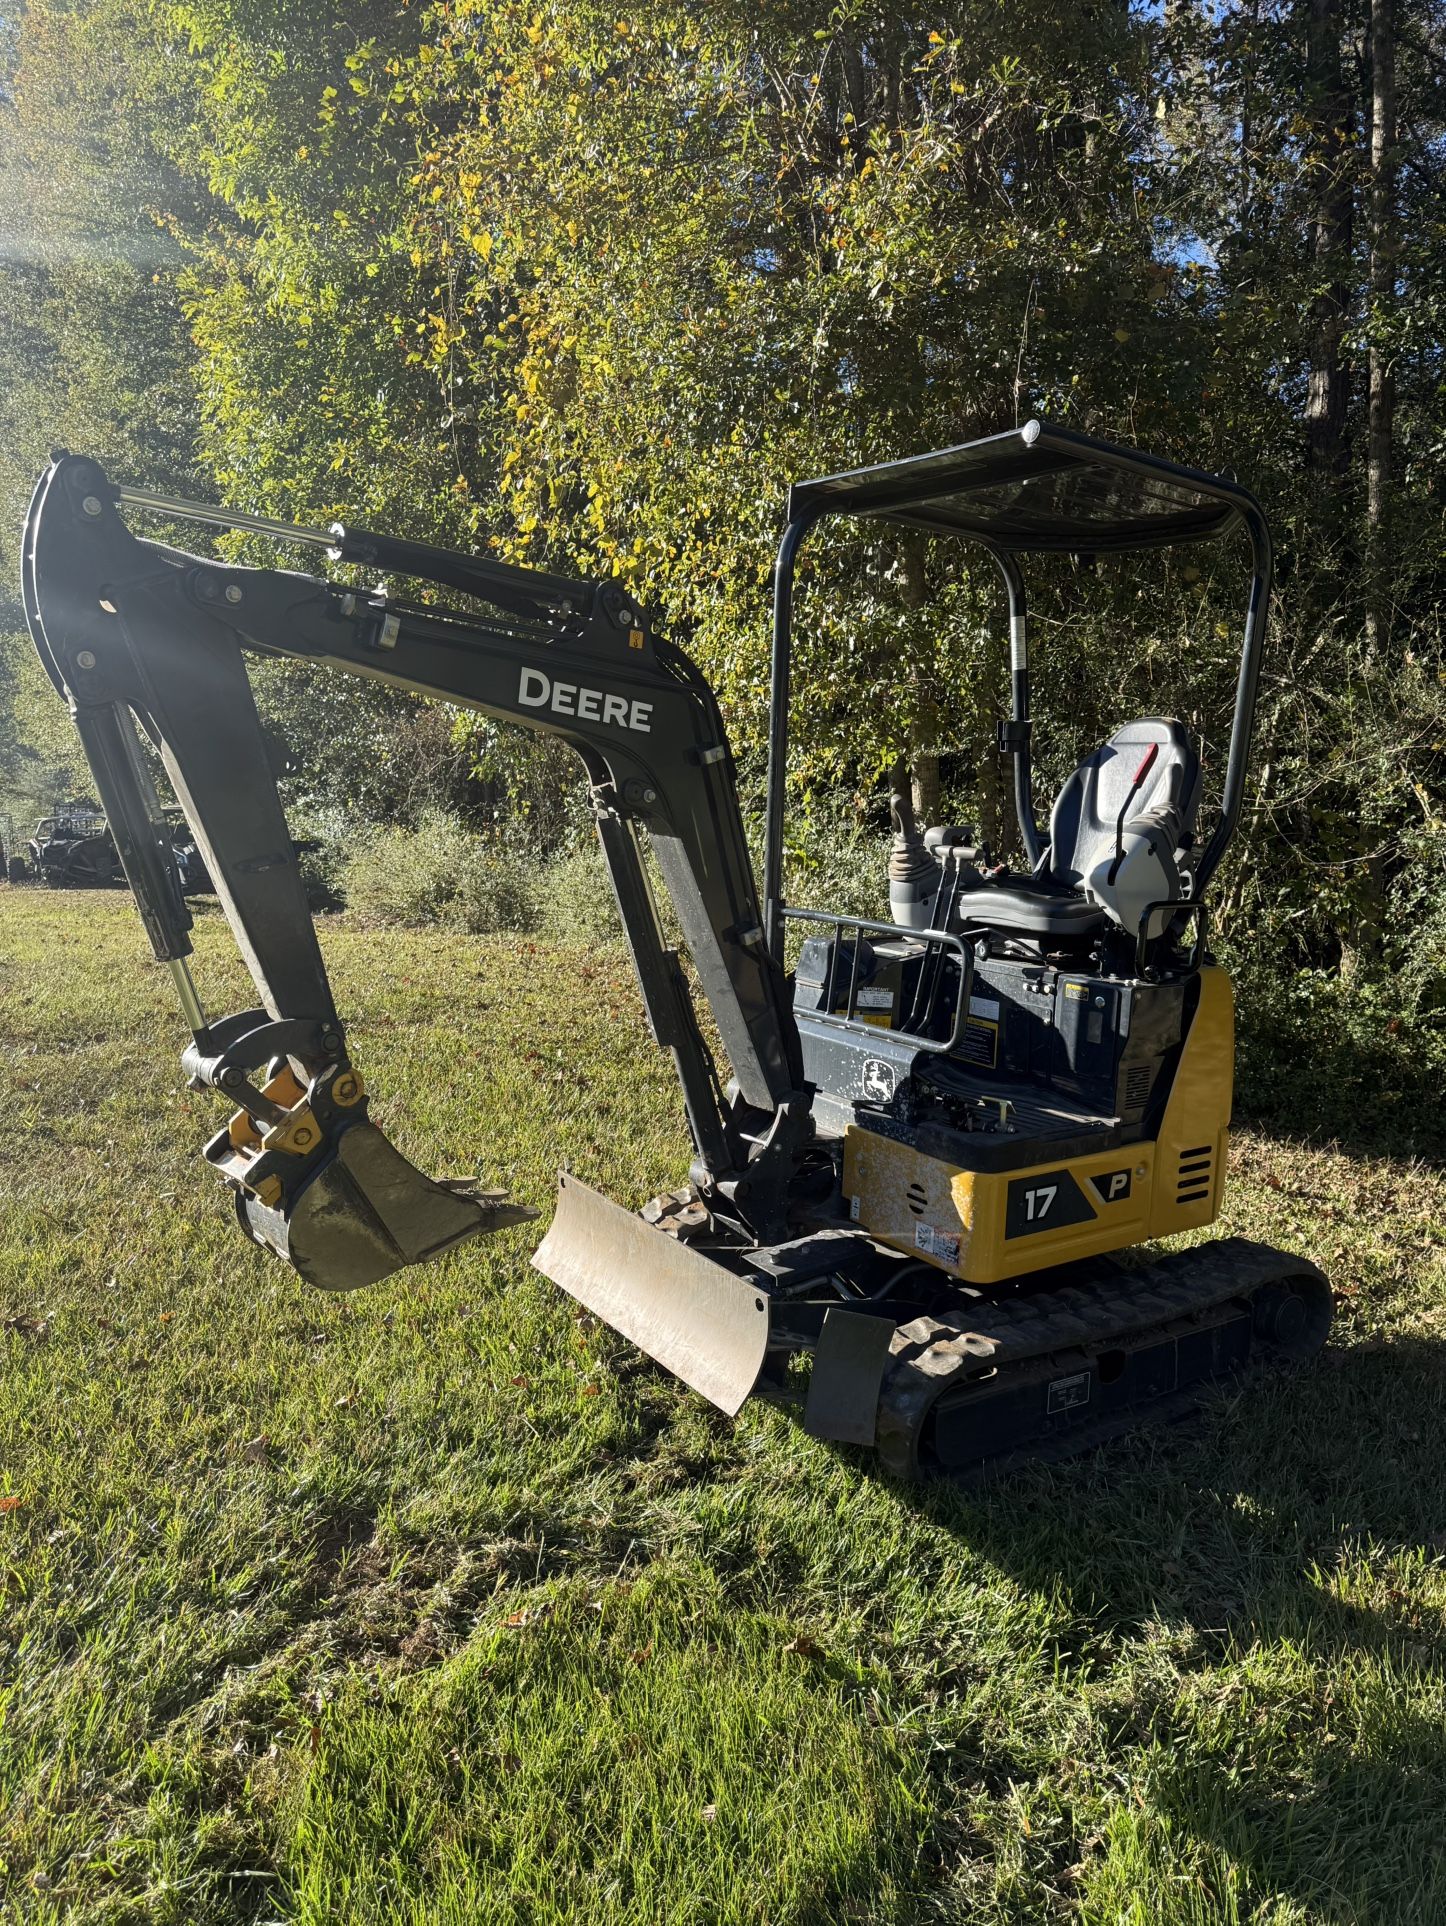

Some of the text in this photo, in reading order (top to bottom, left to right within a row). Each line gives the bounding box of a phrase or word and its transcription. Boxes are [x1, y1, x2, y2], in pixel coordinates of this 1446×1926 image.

[518, 667, 653, 733] DEERE
[1025, 1173, 1128, 1221] 17 P
